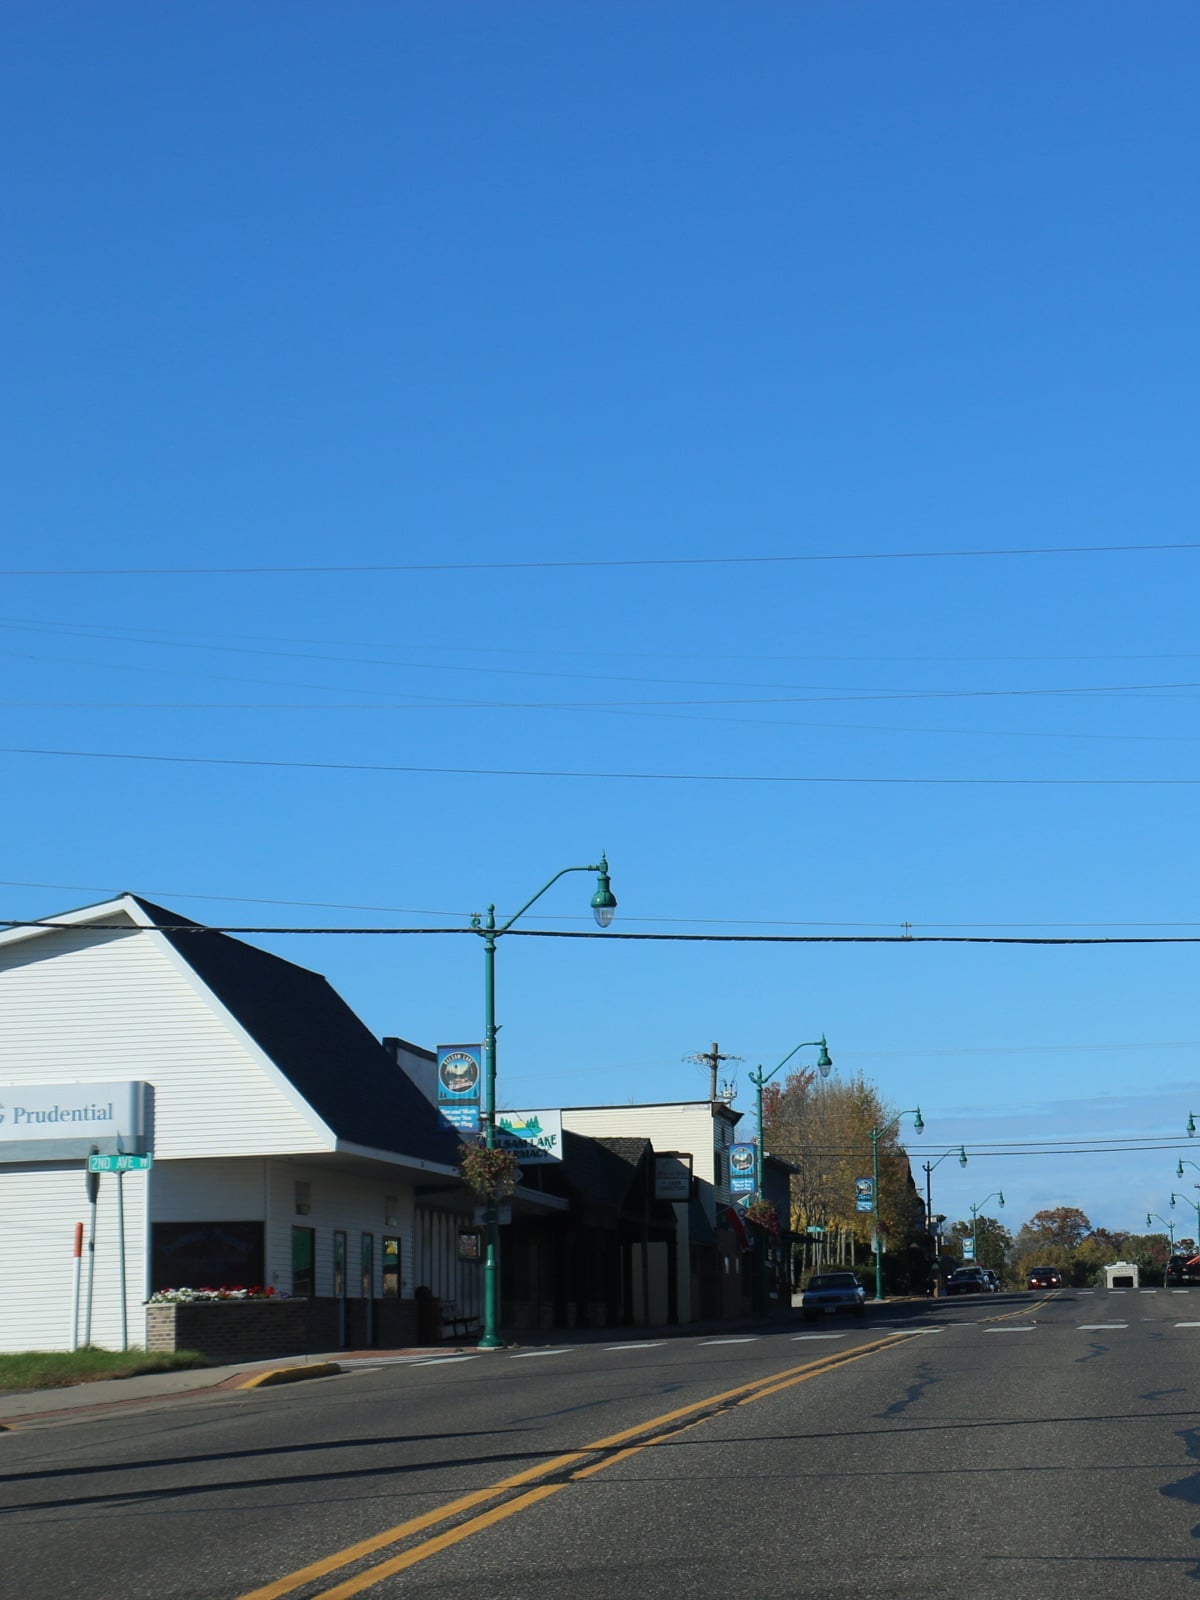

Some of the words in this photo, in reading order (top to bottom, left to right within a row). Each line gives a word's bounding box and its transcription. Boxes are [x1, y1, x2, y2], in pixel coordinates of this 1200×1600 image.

[13, 1103, 113, 1125] Prudential
[531, 1133, 558, 1149] LAKE
[91, 1157, 110, 1170] 2ND
[116, 1156, 134, 1169] AVE
[140, 1157, 149, 1168] W
